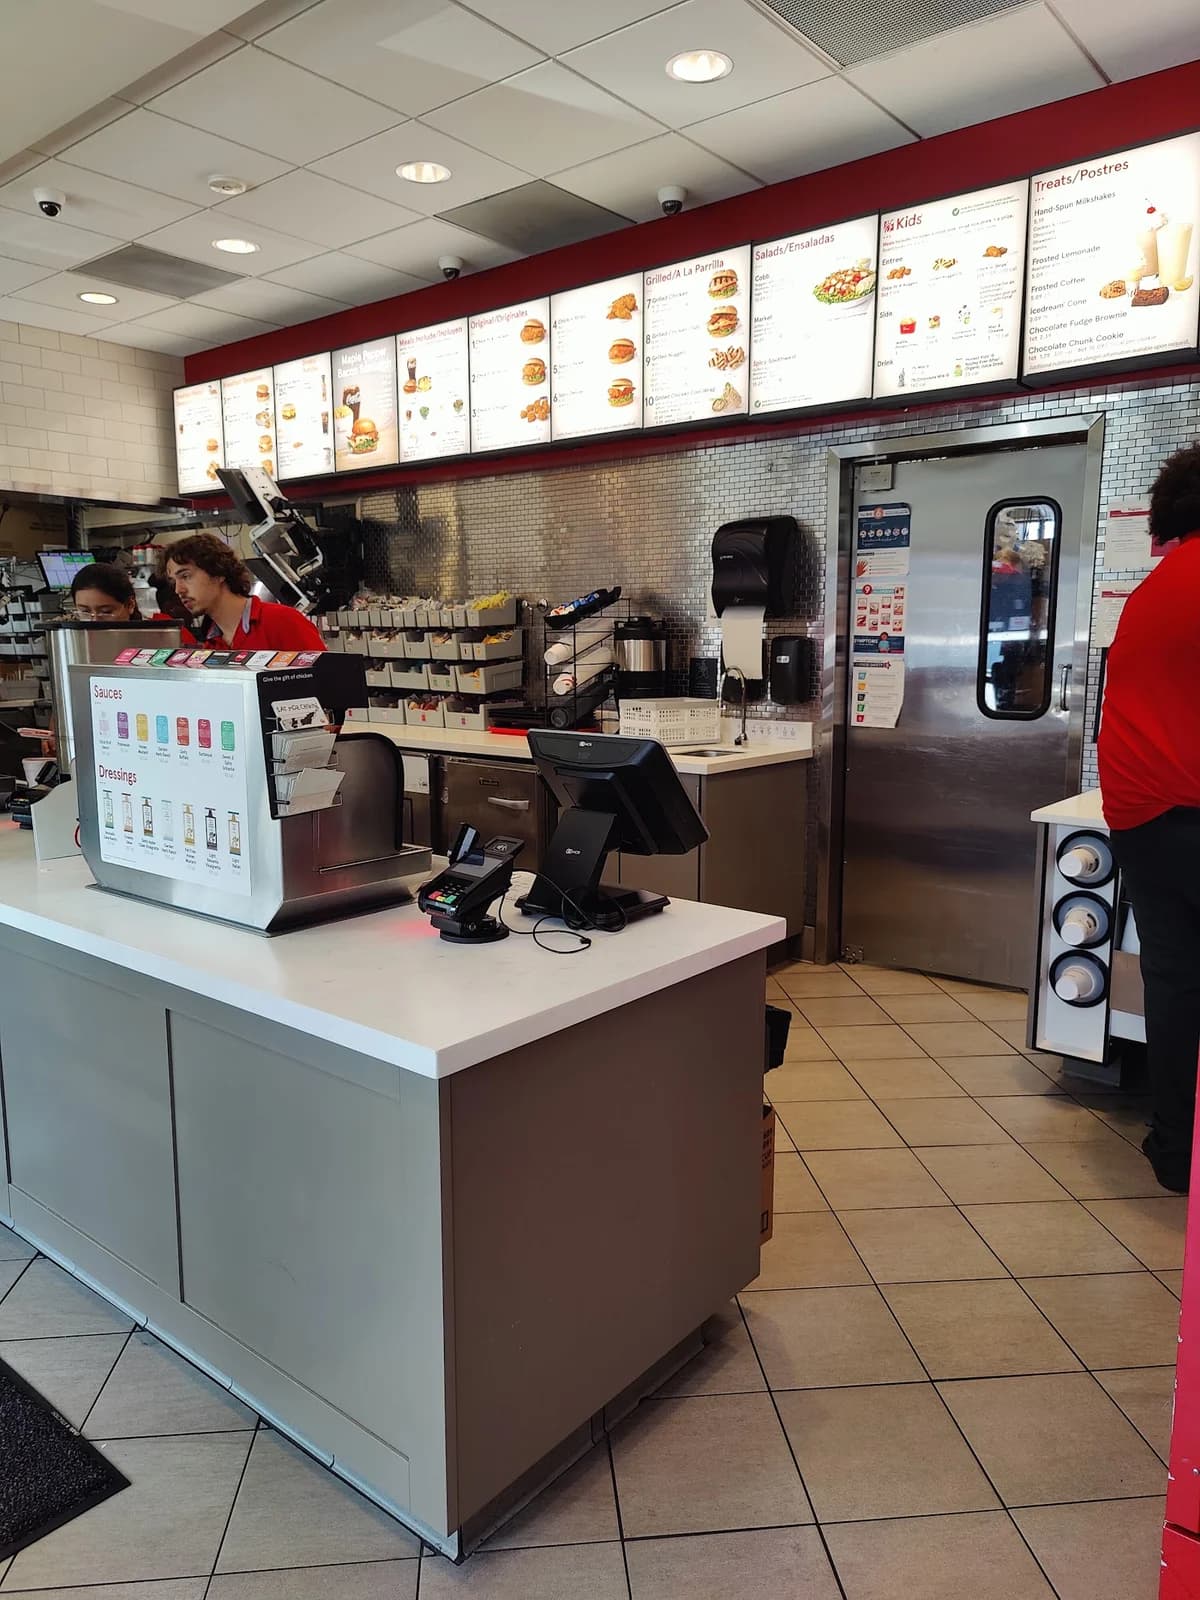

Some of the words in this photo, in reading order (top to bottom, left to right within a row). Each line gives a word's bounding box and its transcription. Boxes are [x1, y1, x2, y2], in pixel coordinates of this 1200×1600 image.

[1034, 160, 1129, 193] Treats/Postres
[1033, 202, 1074, 217] Hand-Spun
[1075, 193, 1117, 208] Milkshakes
[896, 213, 922, 231] Kids
[754, 234, 836, 262] Salads/Ensaladas
[1031, 252, 1060, 266] Frosted
[1061, 245, 1101, 259] Lemonade
[646, 270, 681, 287] Grilled/A
[684, 267, 693, 278] La
[695, 259, 724, 274] Parrilla
[1030, 281, 1059, 295] Frosted
[1060, 276, 1086, 288] Coffee
[647, 298, 653, 310] 7
[1067, 298, 1087, 308] Cone
[552, 320, 558, 330] 4
[1028, 322, 1068, 335] Chocolate
[1069, 316, 1093, 329] Fudge
[1094, 310, 1128, 323] Brownie
[646, 334, 652, 345] 8
[1027, 341, 1067, 355] Chocolate
[1068, 336, 1094, 349] Chunk
[1095, 331, 1124, 344] Cookie
[552, 365, 558, 375] 5
[645, 356, 651, 367] 9
[552, 394, 558, 404] 6
[645, 395, 655, 408] 10
[94, 684, 123, 700] Sauces
[99, 764, 137, 786] Dressings
